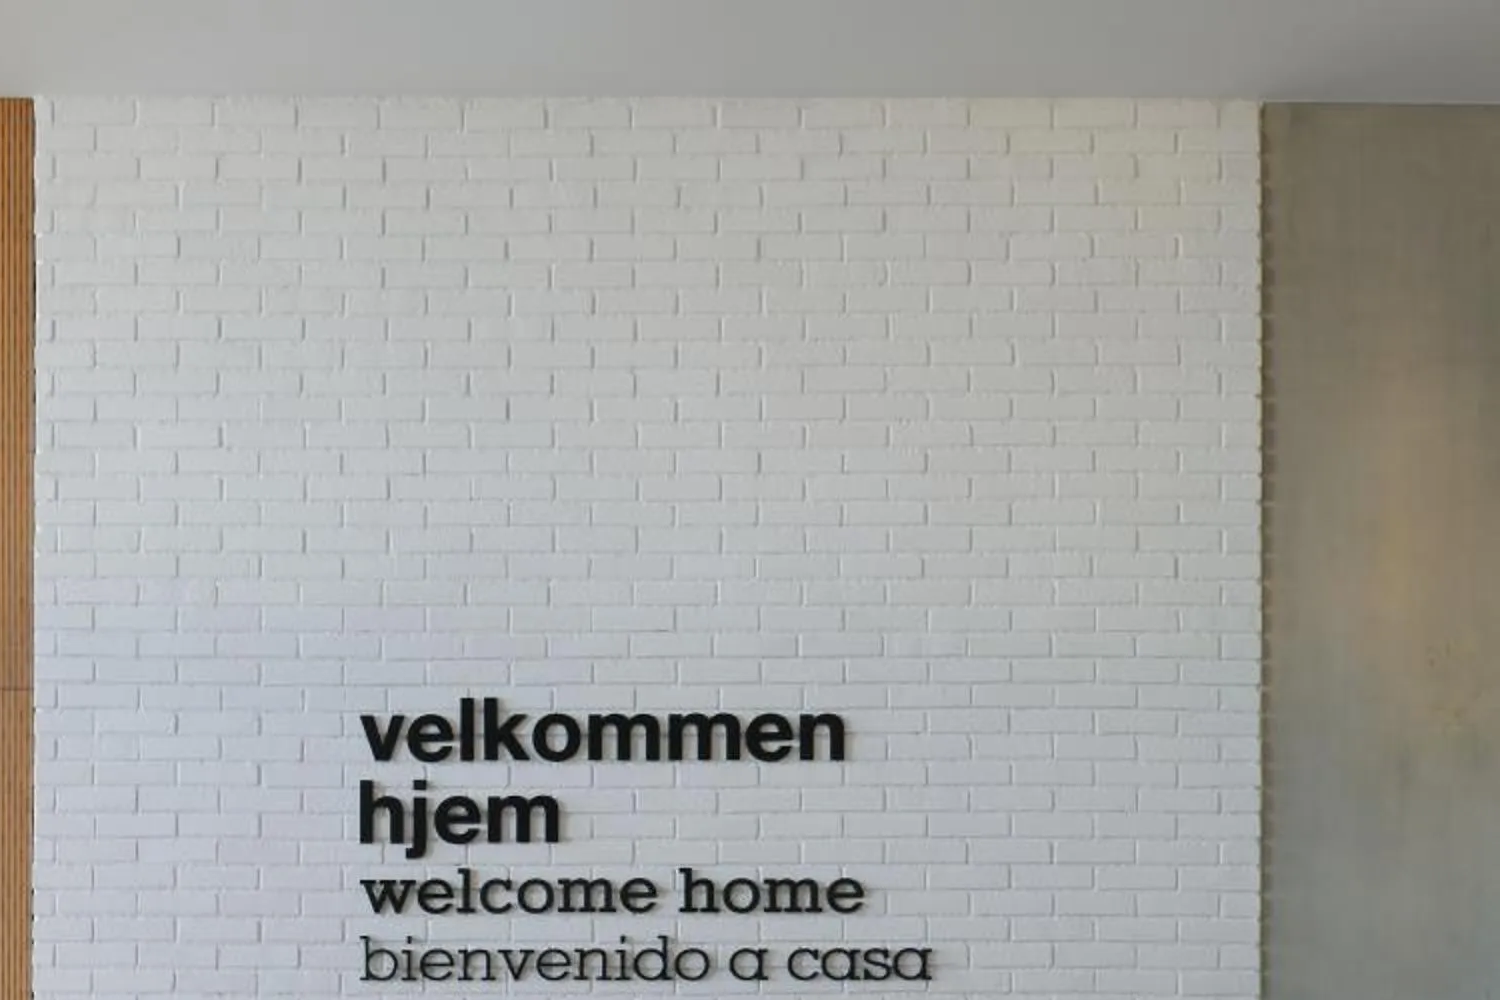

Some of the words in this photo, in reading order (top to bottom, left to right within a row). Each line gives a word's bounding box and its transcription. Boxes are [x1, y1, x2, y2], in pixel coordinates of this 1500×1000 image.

[360, 698, 845, 762] velkommen
[360, 780, 560, 859] hjem
[360, 868, 659, 914] welcome
[679, 868, 865, 914] home
[360, 936, 710, 981] bienvenido
[729, 948, 769, 981] a
[787, 948, 933, 981] casa
